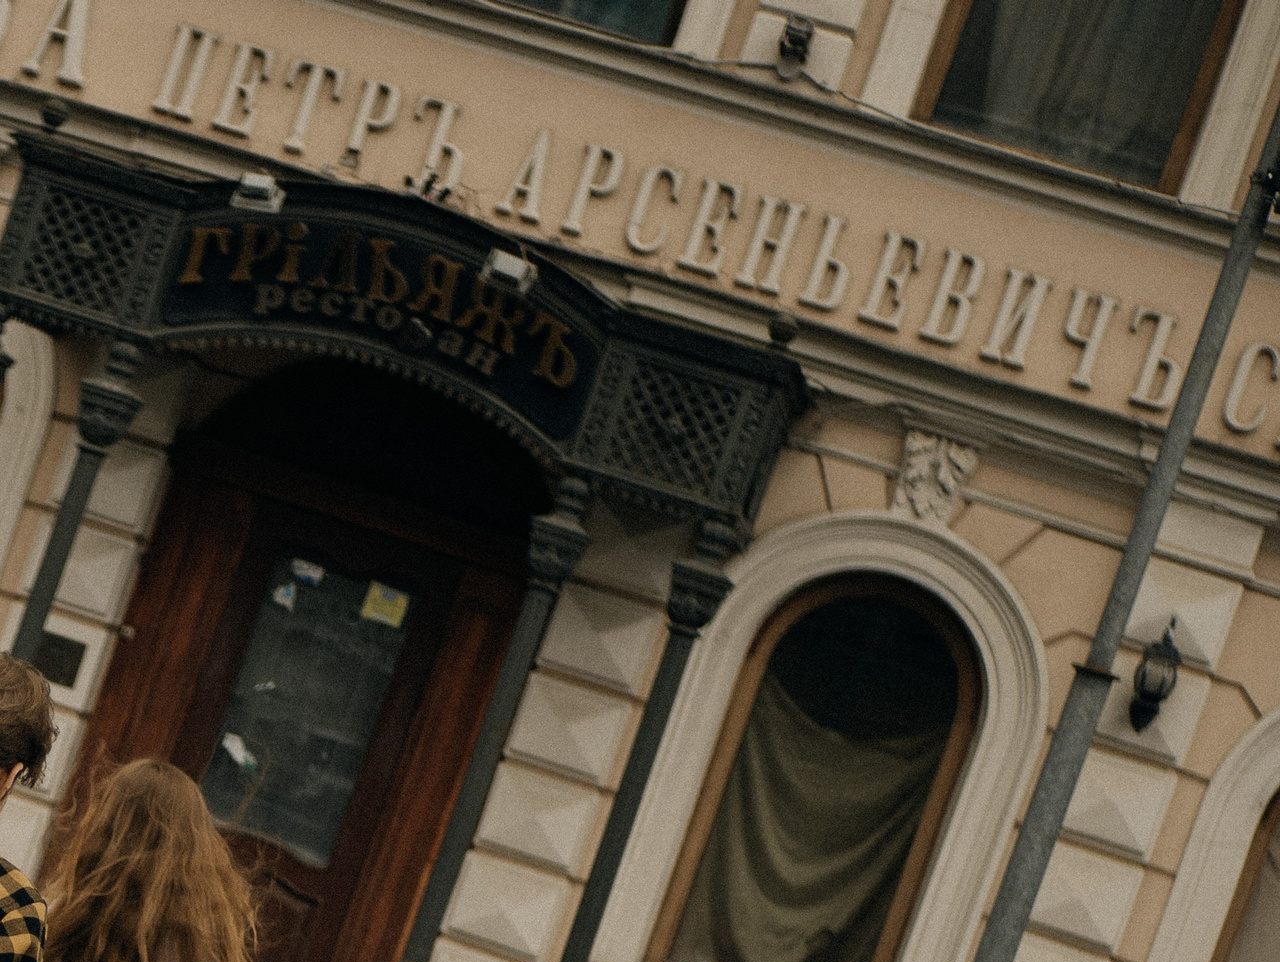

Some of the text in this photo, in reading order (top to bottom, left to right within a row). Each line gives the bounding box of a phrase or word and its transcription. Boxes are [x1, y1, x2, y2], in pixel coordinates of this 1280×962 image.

[153, 25, 462, 200] ПЕТРЪ
[495, 129, 1181, 412] АРСЕНЬЕВИЧЪ
[253, 283, 500, 376] рестоан
